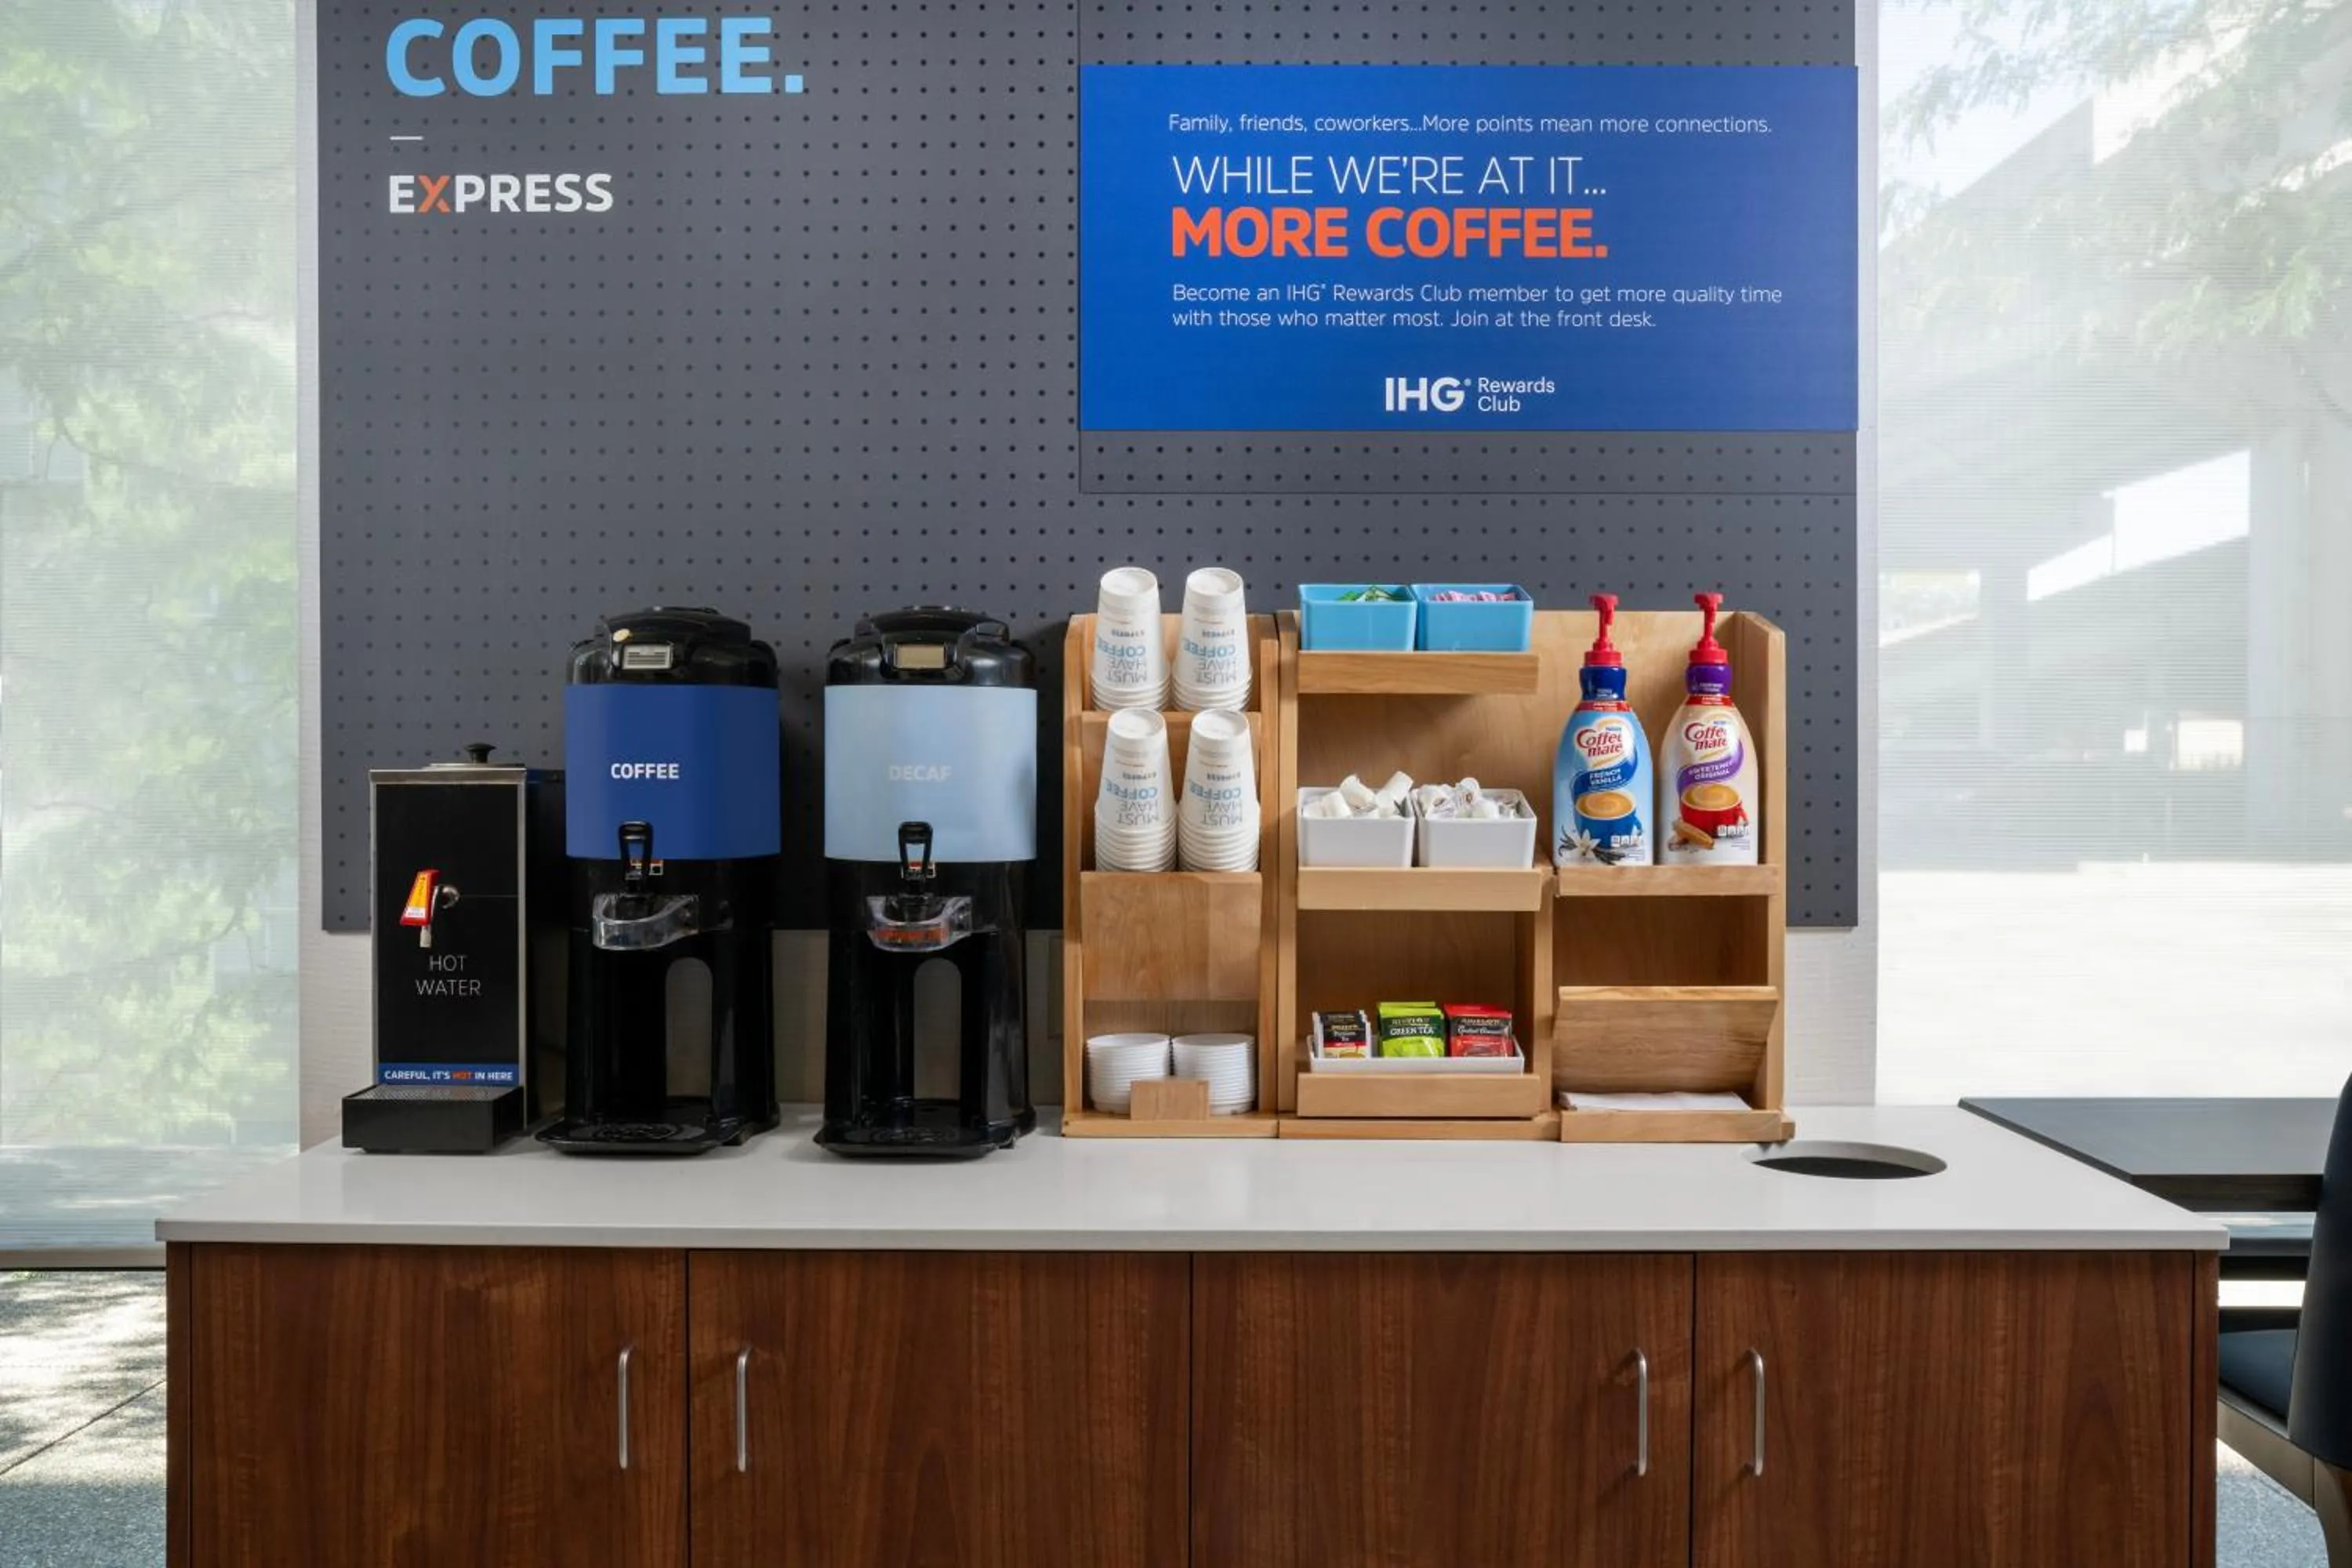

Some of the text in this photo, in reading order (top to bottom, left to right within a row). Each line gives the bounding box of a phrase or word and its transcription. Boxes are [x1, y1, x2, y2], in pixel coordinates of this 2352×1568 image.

[385, 16, 804, 97] COFFEE.
[1169, 114, 1233, 134] Family,
[1240, 114, 1308, 134] friends,
[1475, 114, 1534, 135] points
[1541, 118, 1593, 132] mean
[1599, 118, 1650, 132] more
[1654, 115, 1772, 132] connections.
[1172, 156, 1607, 194] WHILE WE'RE AT IT...
[389, 172, 615, 214] EXPRESS
[1172, 207, 1608, 258] MORE COFFEE.
[1173, 284, 1250, 301] Become
[1257, 288, 1279, 301] an
[1333, 284, 1414, 302] Rewards
[1420, 284, 1462, 302] Club
[1468, 285, 1548, 303] member
[1555, 287, 1574, 303] to
[1579, 288, 1611, 307] get
[1617, 289, 1666, 303] more
[1673, 285, 1735, 307] quality
[1740, 286, 1783, 303] time
[1173, 310, 1657, 328] with those who matter most. Join at the front desk.
[1478, 377, 1555, 394] Rewards
[1478, 395, 1521, 412] Club
[1105, 658, 1147, 671] HAVE
[1196, 658, 1236, 671] HAVE
[1105, 670, 1148, 684] MUST
[1195, 671, 1237, 684] MUST
[611, 762, 680, 779] COFFEE
[889, 764, 953, 782] DECAF
[1117, 800, 1159, 813] HAVE
[1203, 800, 1242, 814] HAVE
[1116, 814, 1159, 826] MUST
[1201, 815, 1243, 826] MUST
[429, 955, 467, 972] HOT
[416, 978, 482, 996] WATER
[1389, 1025, 1435, 1036] GREEN TEA
[383, 1069, 430, 1080] CAREFUL,
[452, 1072, 471, 1080] HOT
[474, 1072, 485, 1080] IN
[487, 1072, 514, 1081] HERE
